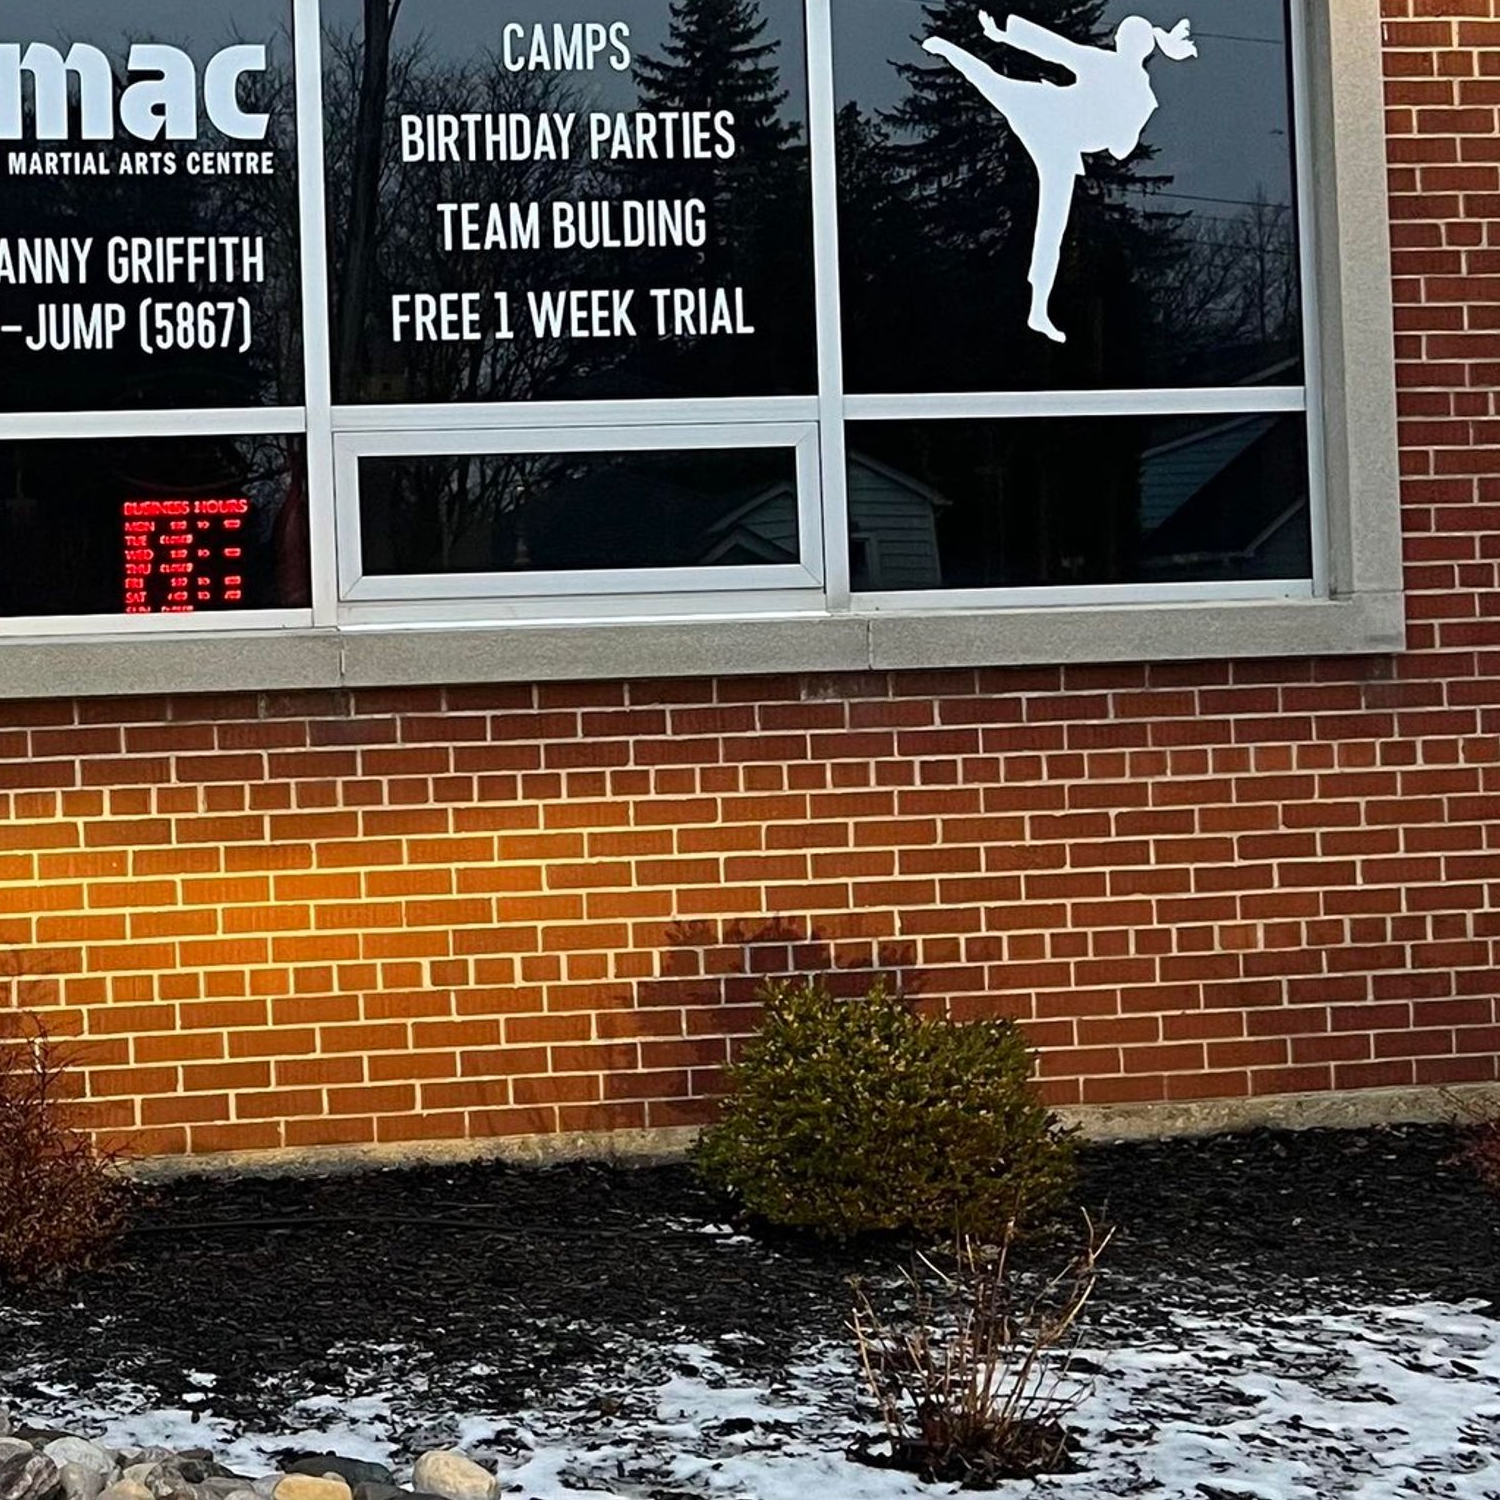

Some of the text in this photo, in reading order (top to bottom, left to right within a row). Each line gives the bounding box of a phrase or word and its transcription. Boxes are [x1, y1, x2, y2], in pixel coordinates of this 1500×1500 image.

[503, 21, 631, 72] CAMPS
[401, 109, 736, 162] BIRTHDAY PARTIES
[8, 152, 110, 175] MARTIAL
[119, 152, 177, 175] ARTS
[186, 151, 274, 175] CENTRE
[436, 198, 707, 251] TEAM BULDING
[107, 236, 264, 284] GRIFFITH
[139, 296, 252, 354] (5867)
[392, 287, 755, 342] FREE 1 WEEK TRIAL
[124, 499, 248, 515] BUSINESS HOURS
[125, 591, 147, 603] SAT
